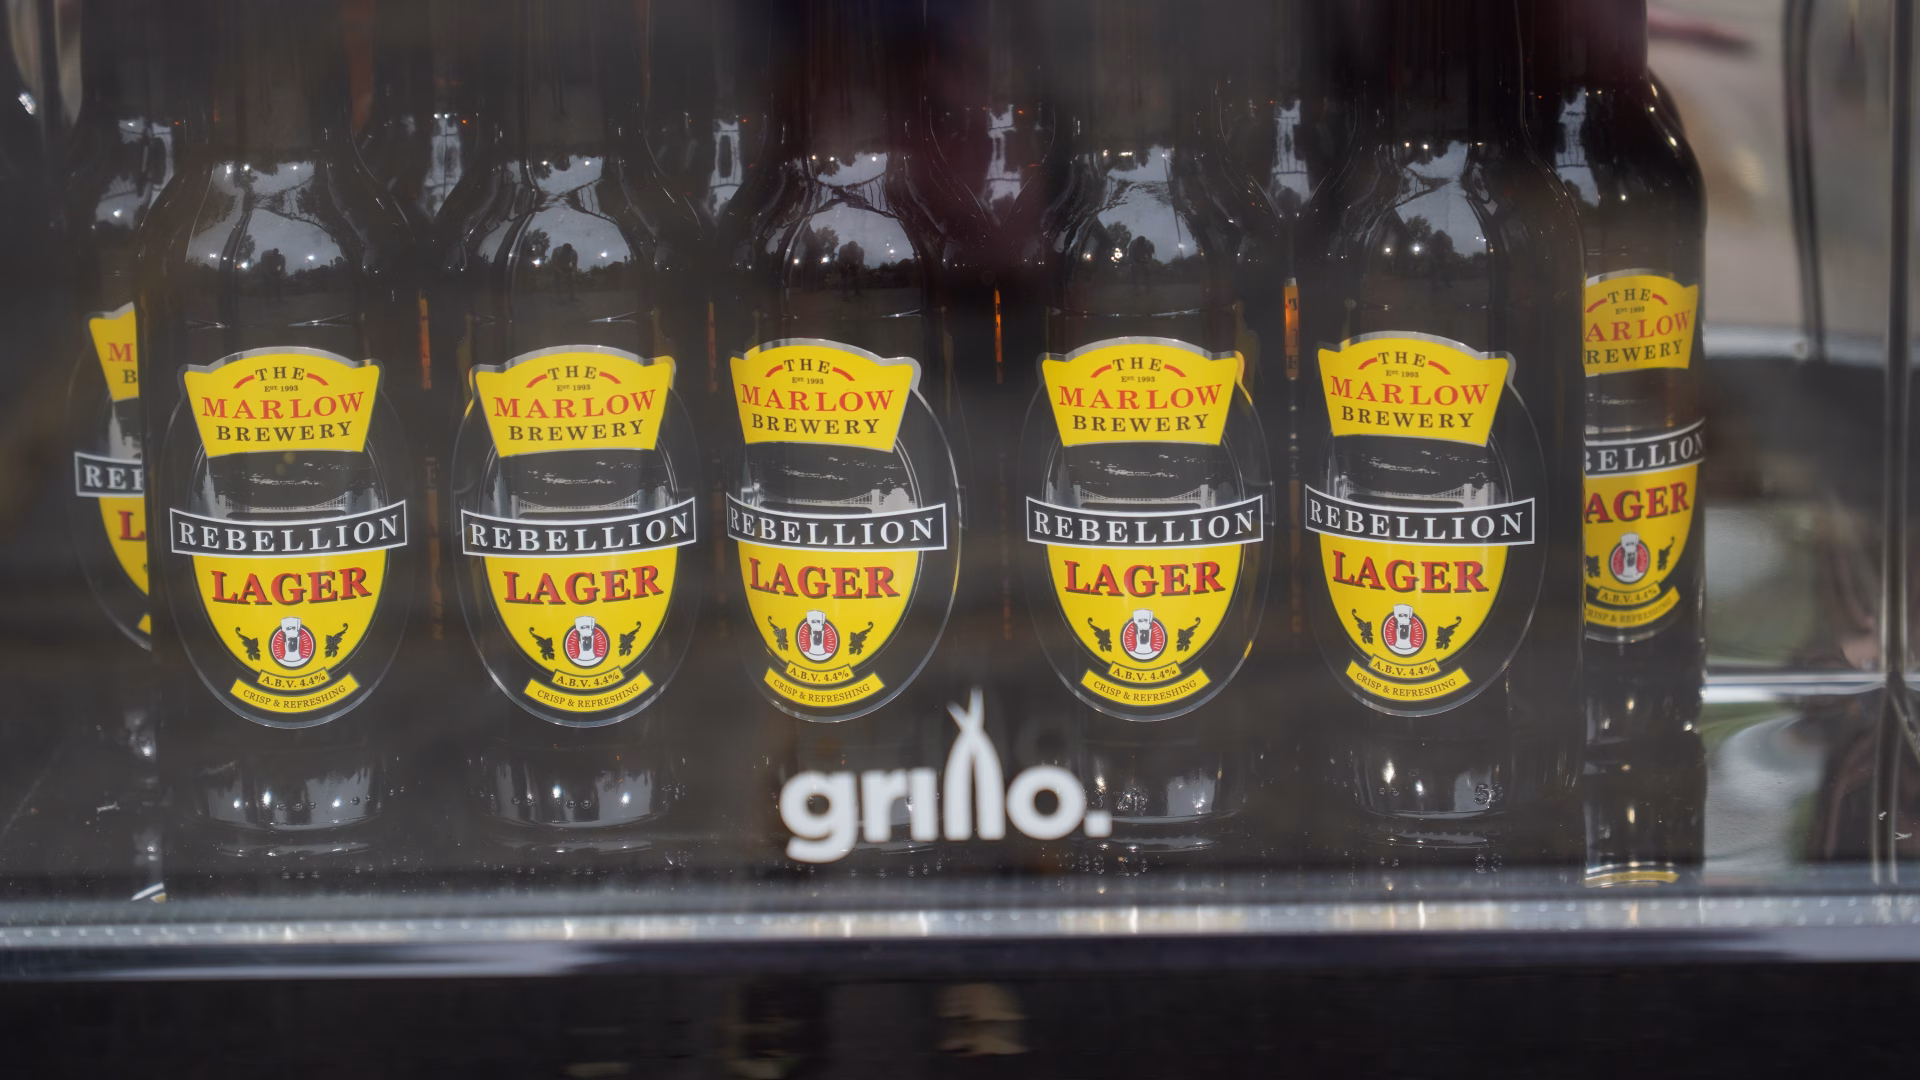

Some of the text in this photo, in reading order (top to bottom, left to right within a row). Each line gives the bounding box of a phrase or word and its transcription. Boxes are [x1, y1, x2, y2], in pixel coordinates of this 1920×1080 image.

[1608, 288, 1650, 304] THE
[1585, 310, 1690, 342] ARLOW
[1378, 352, 1425, 367] THE
[1586, 339, 1682, 364] REWERY
[255, 367, 304, 381] THE
[548, 366, 596, 380] THE
[784, 359, 829, 374] THE
[1113, 357, 1161, 371] THE
[280, 384, 298, 392] 1993
[740, 384, 894, 412] MARLOW
[1059, 384, 1222, 409] MARLOW
[1330, 376, 1490, 405] MARLOW
[202, 392, 364, 419] MARLOW
[494, 389, 655, 418] MARLOW
[752, 413, 879, 434] BREWERY
[1073, 414, 1208, 432] BREWERY
[1342, 406, 1473, 428] BREWERY
[216, 421, 352, 441] BREWERY
[509, 419, 643, 441] BREWERY
[1586, 432, 1702, 471] ELLION
[1585, 481, 1689, 523] AGER
[731, 508, 933, 545] REBELLION
[1035, 510, 1253, 543] REBELLION
[1311, 499, 1522, 539] REBELLION
[179, 515, 397, 551] REBELLION
[470, 512, 687, 551] REBELLION
[748, 557, 900, 599] LAGER
[1064, 560, 1226, 598] LAGER
[1332, 550, 1489, 593] LAGER
[211, 567, 372, 606] LAGER
[503, 566, 664, 605] LAGER
[1586, 608, 1608, 619] RISP
[556, 672, 619, 687] A.B.V. 4.4%
[790, 667, 849, 682] A.B.V. 4.4%
[1113, 666, 1176, 682] A.B.V. 4.4%
[1374, 660, 1435, 676] A.B.V. 4.4%
[262, 672, 326, 689] A.B.V. 4.4%
[773, 678, 870, 703] CRISP & REFRESHING
[1094, 679, 1196, 702] CRISP & REFRESHING
[1356, 672, 1456, 698] CRISP & REFRESHING
[243, 685, 345, 708] CRISP & REFRESHING
[537, 685, 639, 708] CRISP & REFRESHING
